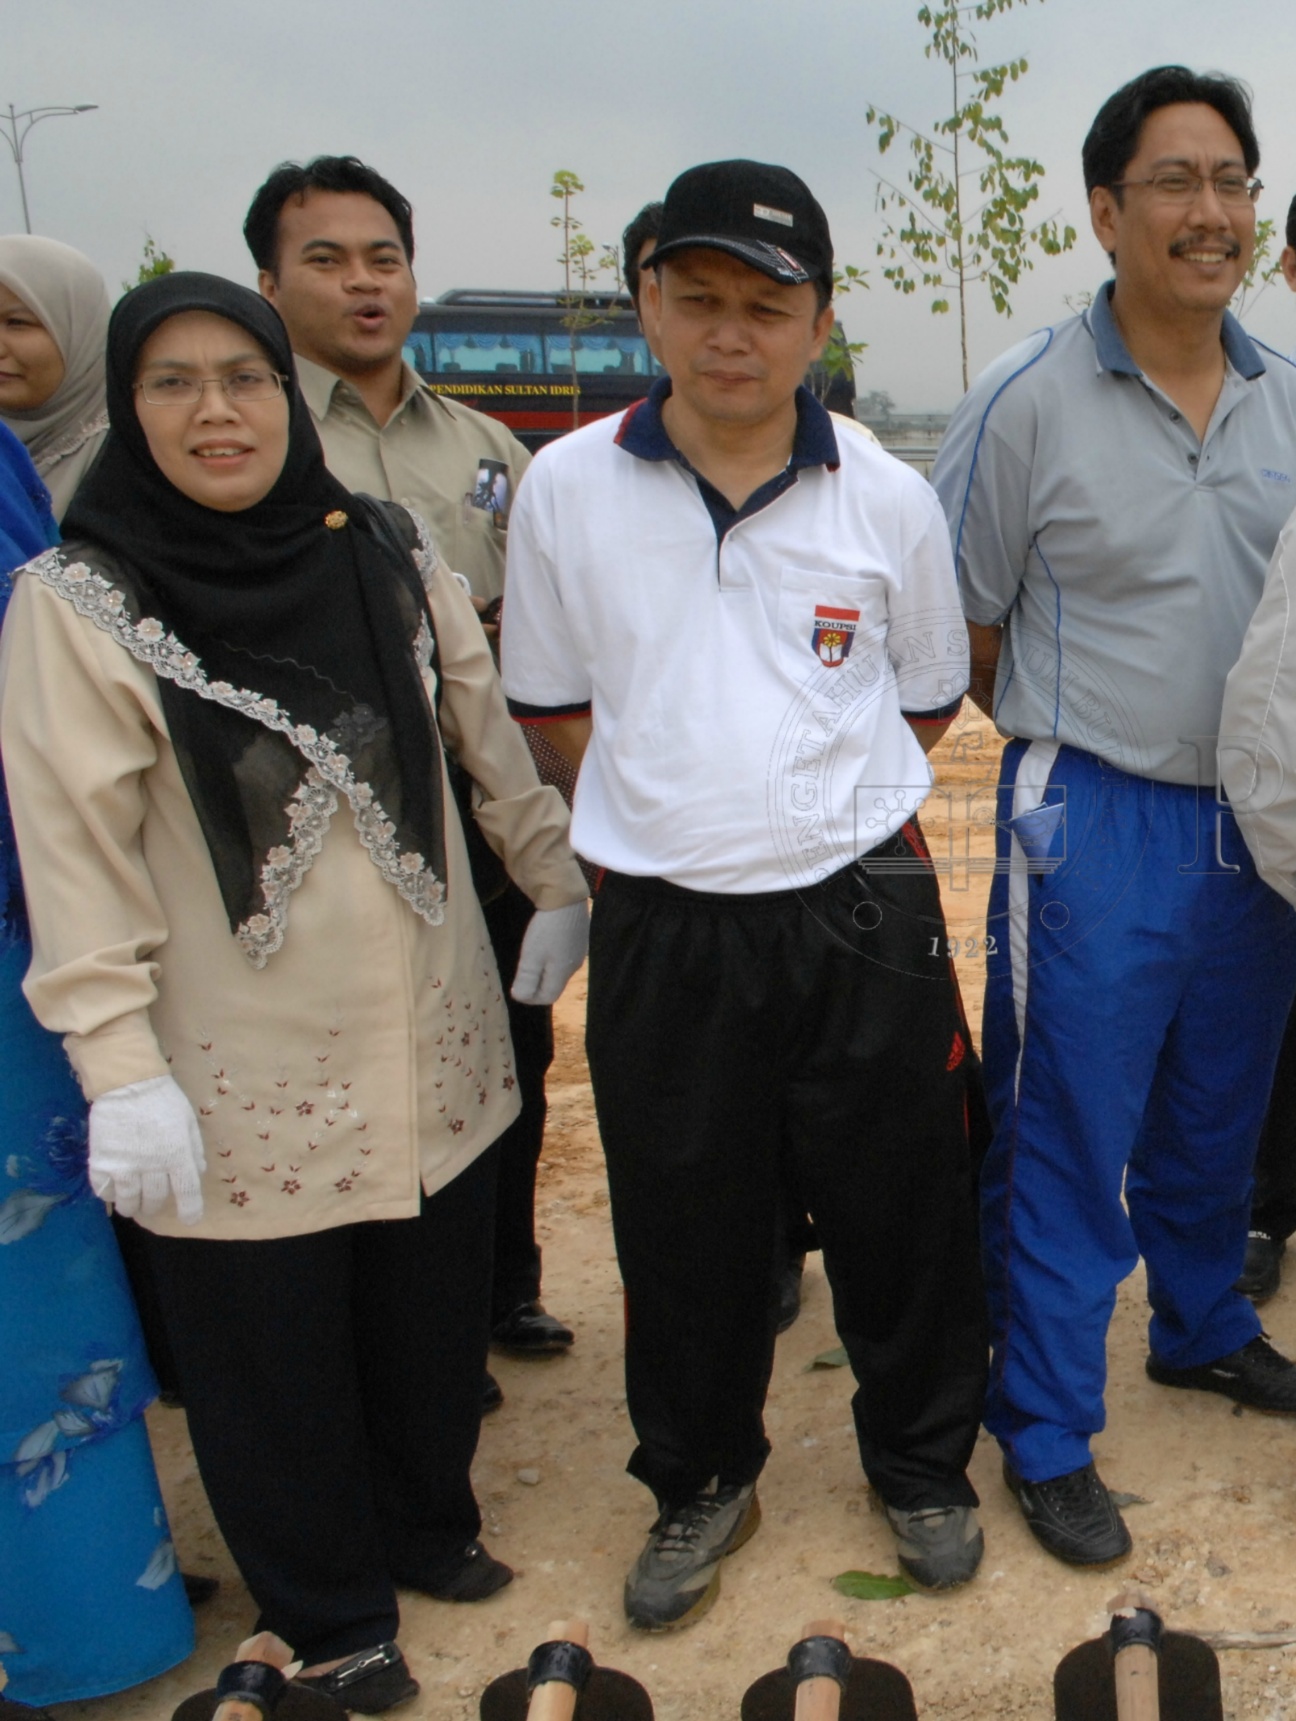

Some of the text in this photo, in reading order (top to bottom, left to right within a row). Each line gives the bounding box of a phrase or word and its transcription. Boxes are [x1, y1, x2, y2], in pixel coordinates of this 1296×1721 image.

[429, 384, 503, 395] PENDIDIKAN
[504, 385, 548, 396] SULTAN
[814, 620, 857, 631] KOUPSI
